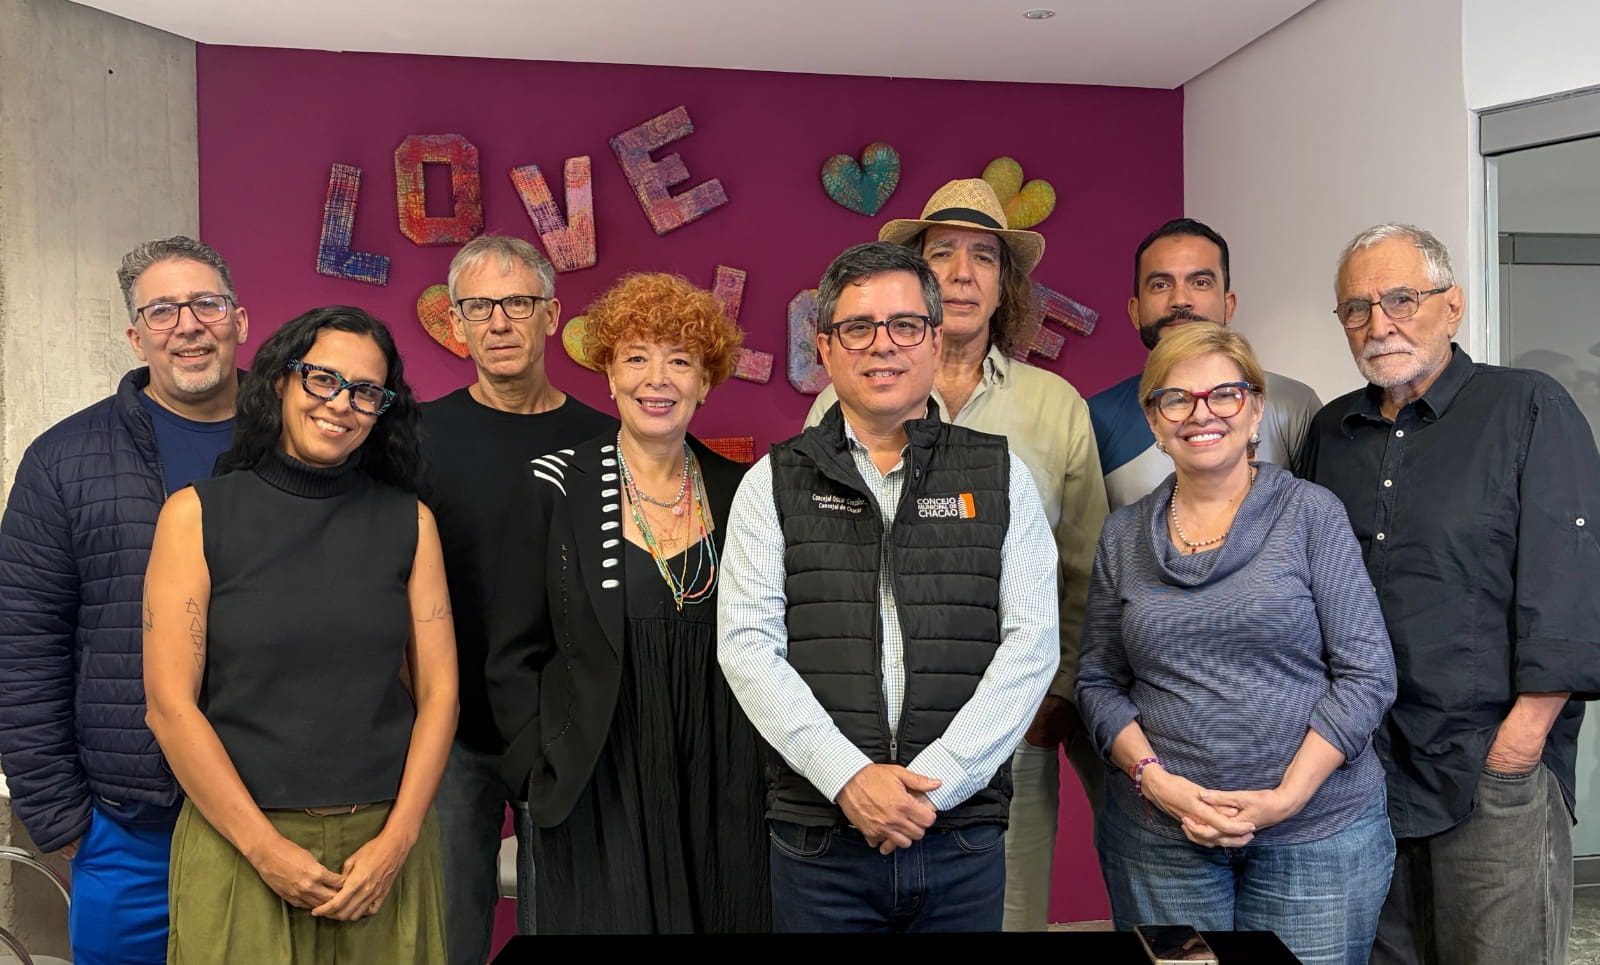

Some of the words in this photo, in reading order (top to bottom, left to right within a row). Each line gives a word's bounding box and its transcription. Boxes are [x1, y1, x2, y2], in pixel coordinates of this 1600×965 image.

[316, 105, 728, 285] LOVE
[917, 497, 956, 505] CONCEJO
[918, 509, 958, 518] CHACAO
